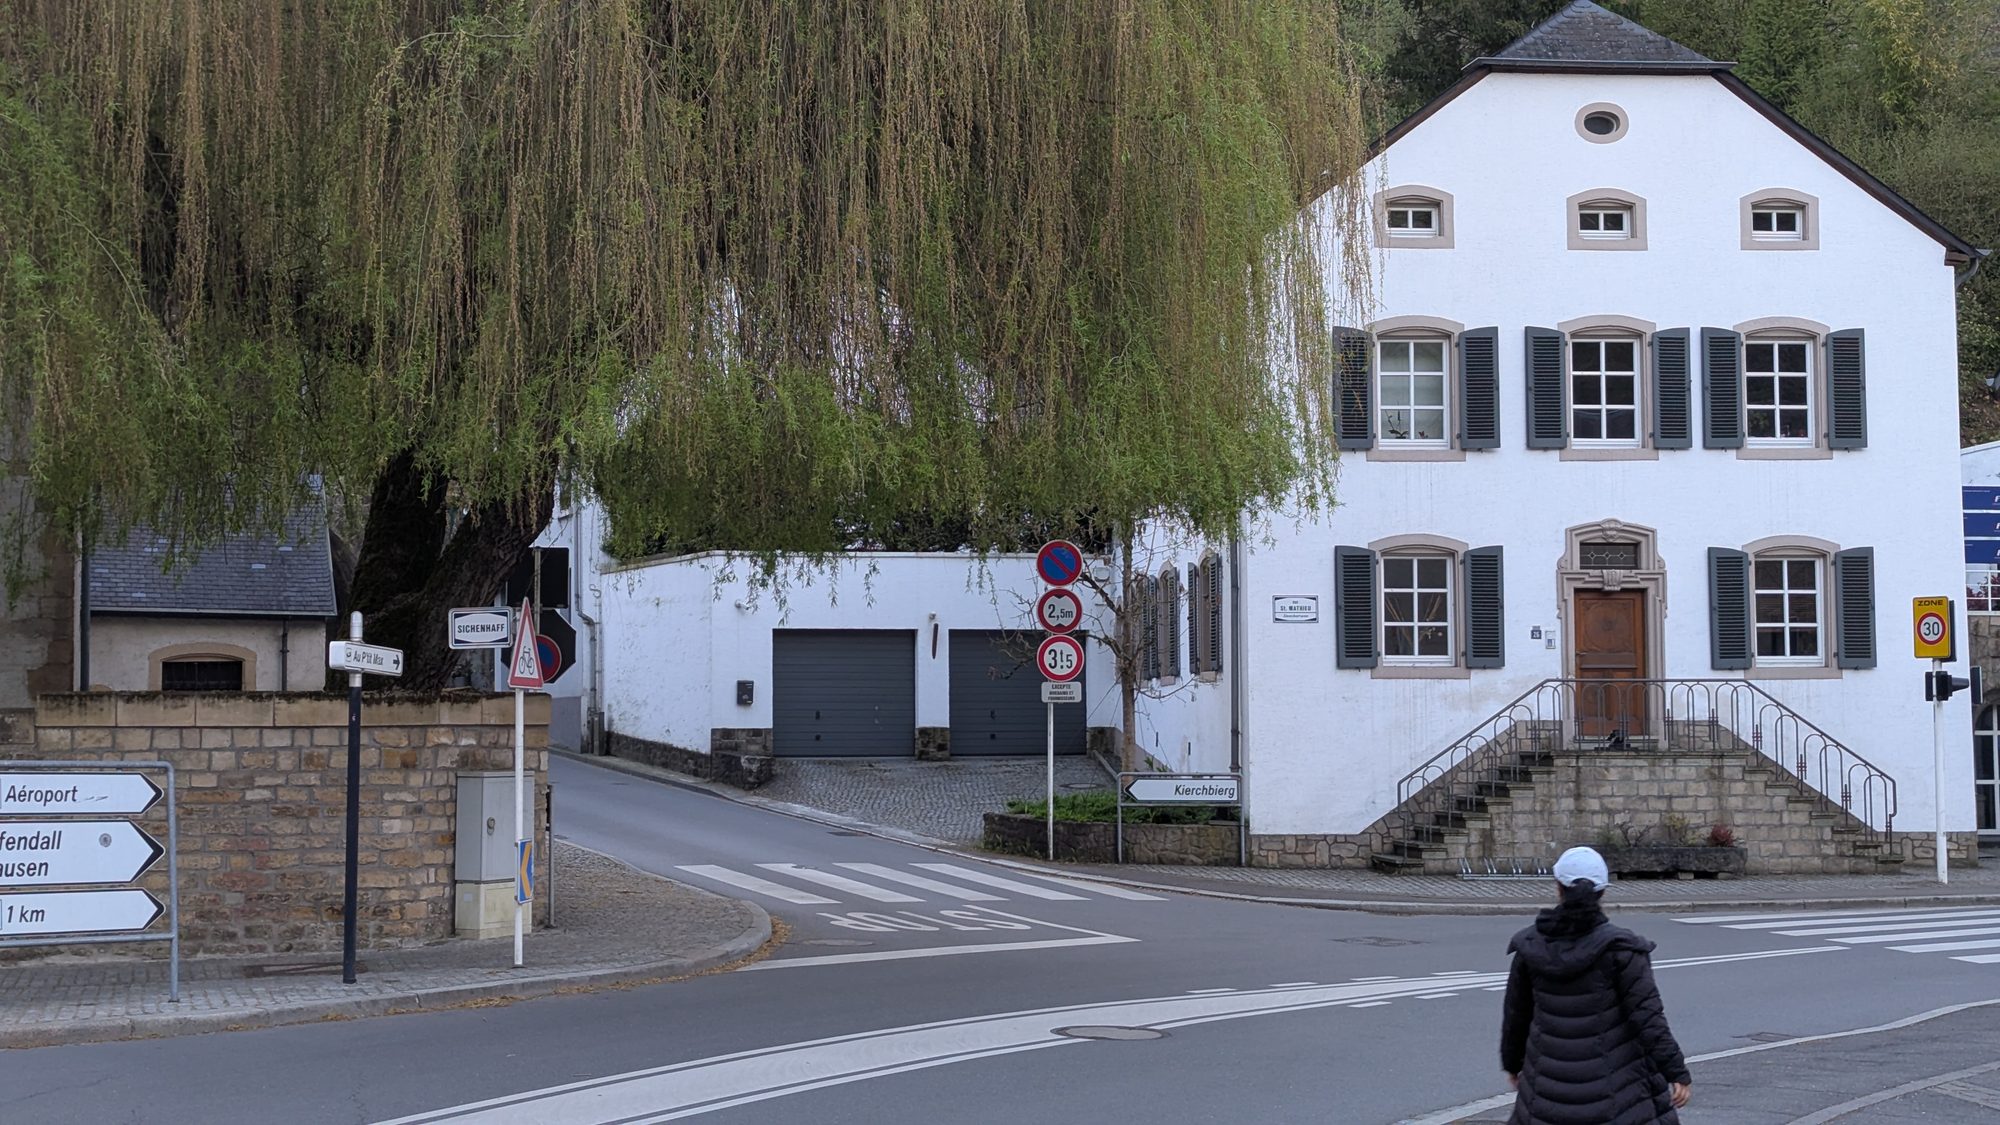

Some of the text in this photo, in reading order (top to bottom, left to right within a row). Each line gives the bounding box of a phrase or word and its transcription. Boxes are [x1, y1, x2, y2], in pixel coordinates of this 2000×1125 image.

[457, 623, 505, 634] SICHENHAFF
[1923, 622, 1940, 636] 30
[5, 785, 79, 807] Aéroport
[1174, 784, 1236, 798] Kierchbierg
[7, 904, 46, 923] 1 km
[815, 910, 1033, 932] STOP
